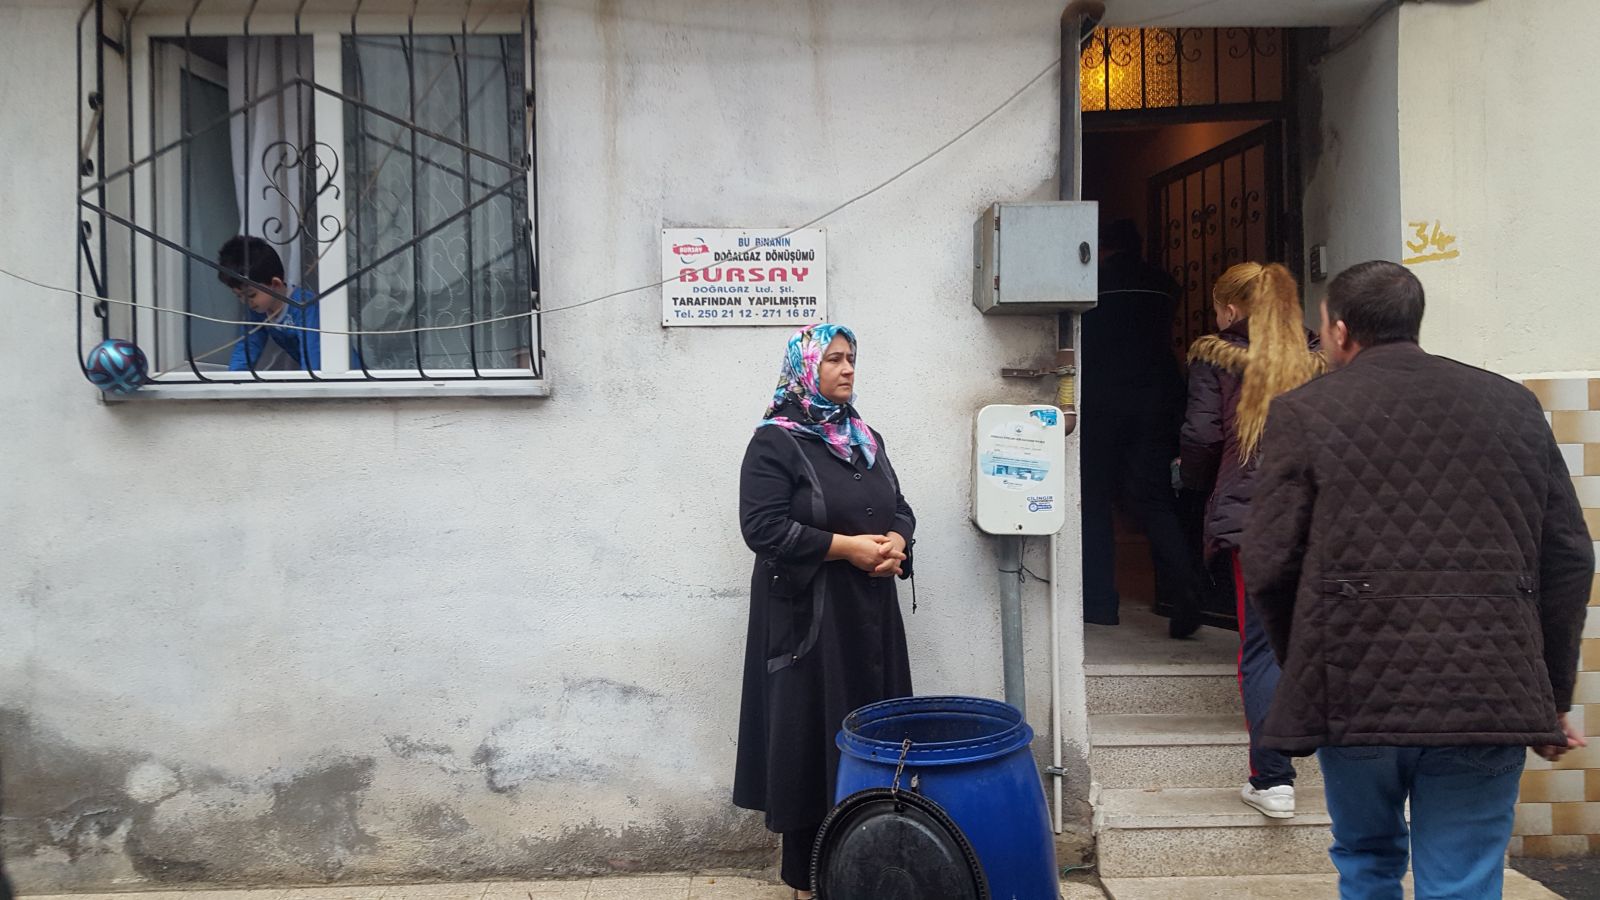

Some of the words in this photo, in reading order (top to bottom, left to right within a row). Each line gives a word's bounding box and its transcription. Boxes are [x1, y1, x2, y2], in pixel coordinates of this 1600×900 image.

[1406, 219, 1456, 252] 34
[738, 237, 750, 247] BU
[714, 250, 761, 261] DOĞALGAZ
[765, 250, 815, 264] DÖNÜŞÜMÜ
[679, 267, 809, 282] BURSAY
[692, 285, 749, 293] DOĞALGAZ
[779, 286, 794, 294] Şti.
[672, 297, 742, 306] TARAFINDAN
[748, 296, 817, 308] YAPILMIŞTIR
[674, 310, 694, 318] Tel.
[698, 310, 718, 318] 250
[721, 310, 734, 318] 21
[739, 310, 752, 318] 12
[762, 309, 781, 318] 271
[787, 309, 799, 318] 16
[802, 309, 816, 318] 87
